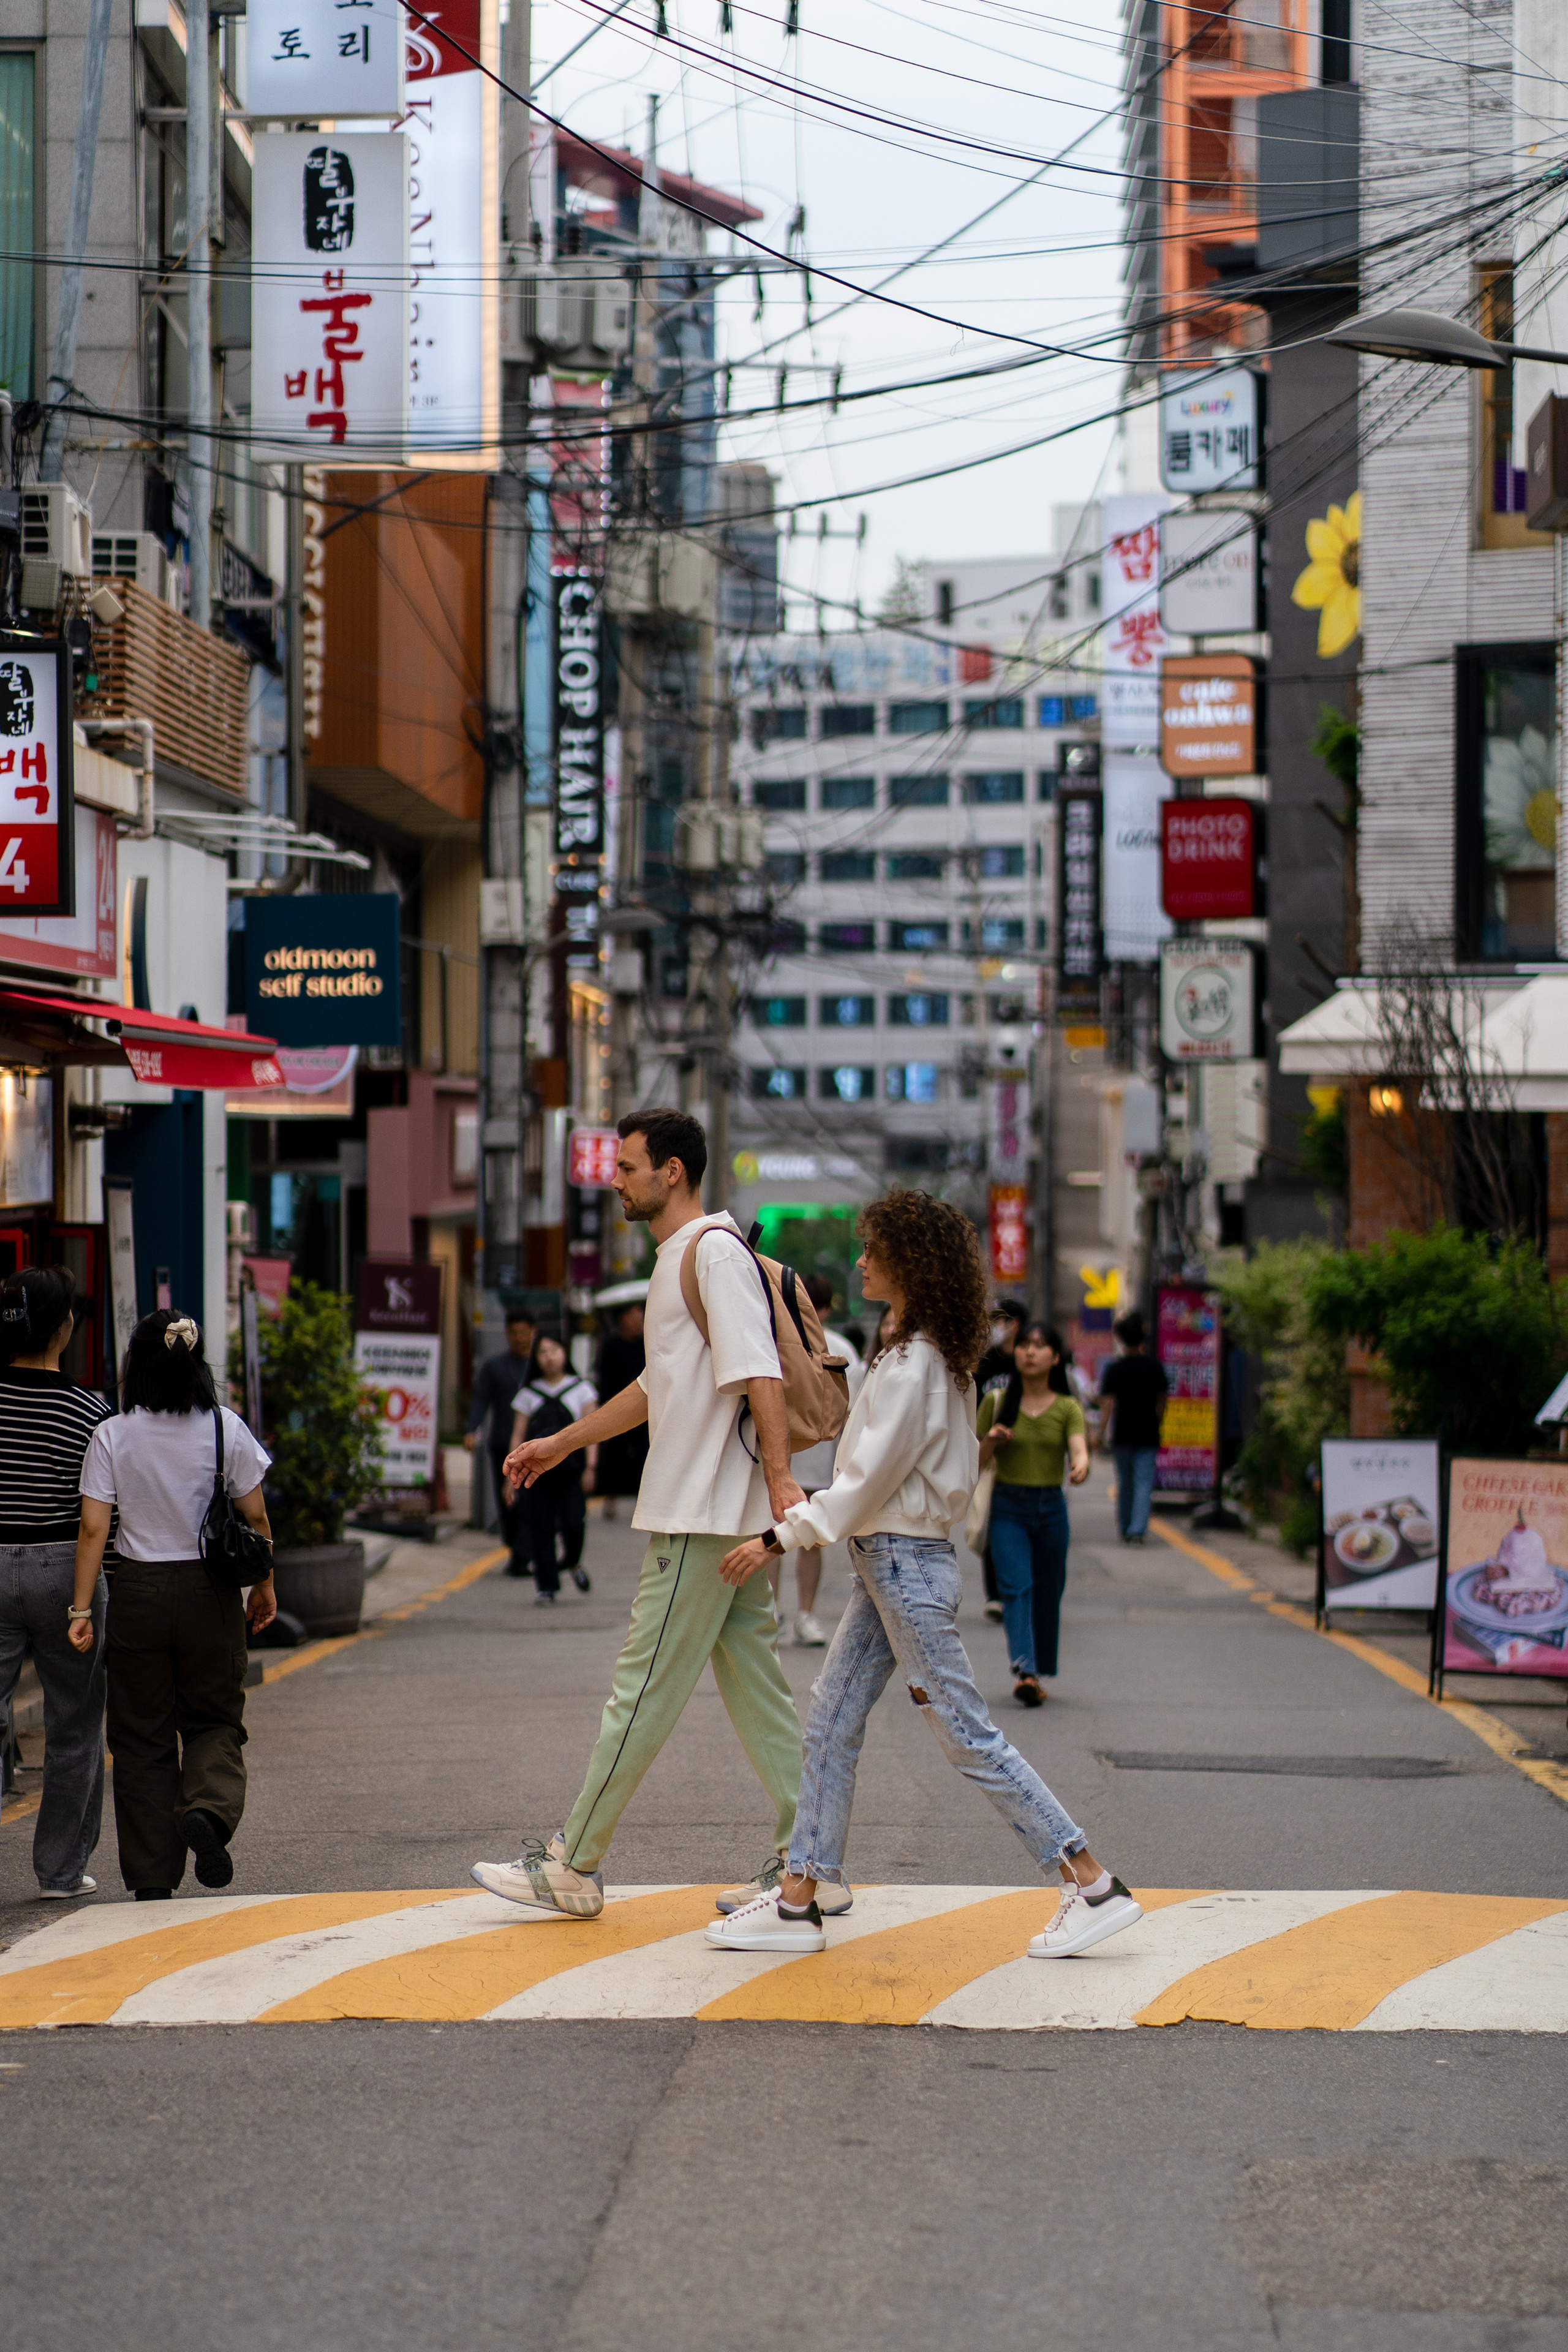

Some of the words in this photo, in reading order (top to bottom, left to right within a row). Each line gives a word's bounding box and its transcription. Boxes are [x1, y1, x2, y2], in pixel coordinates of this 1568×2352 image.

[306, 148, 355, 252] 딸부자네
[284, 268, 372, 445] 불백
[1180, 399, 1234, 418] Luxury
[1166, 424, 1249, 473] 룸카페
[559, 581, 600, 719] CHOP
[0, 663, 34, 736] 딸부자네
[559, 728, 599, 851] HAIR
[1167, 814, 1247, 840] PHOTO
[1167, 838, 1244, 864] DRINK
[263, 946, 377, 971] oldmoon
[258, 971, 305, 998] self
[306, 971, 384, 998] studio
